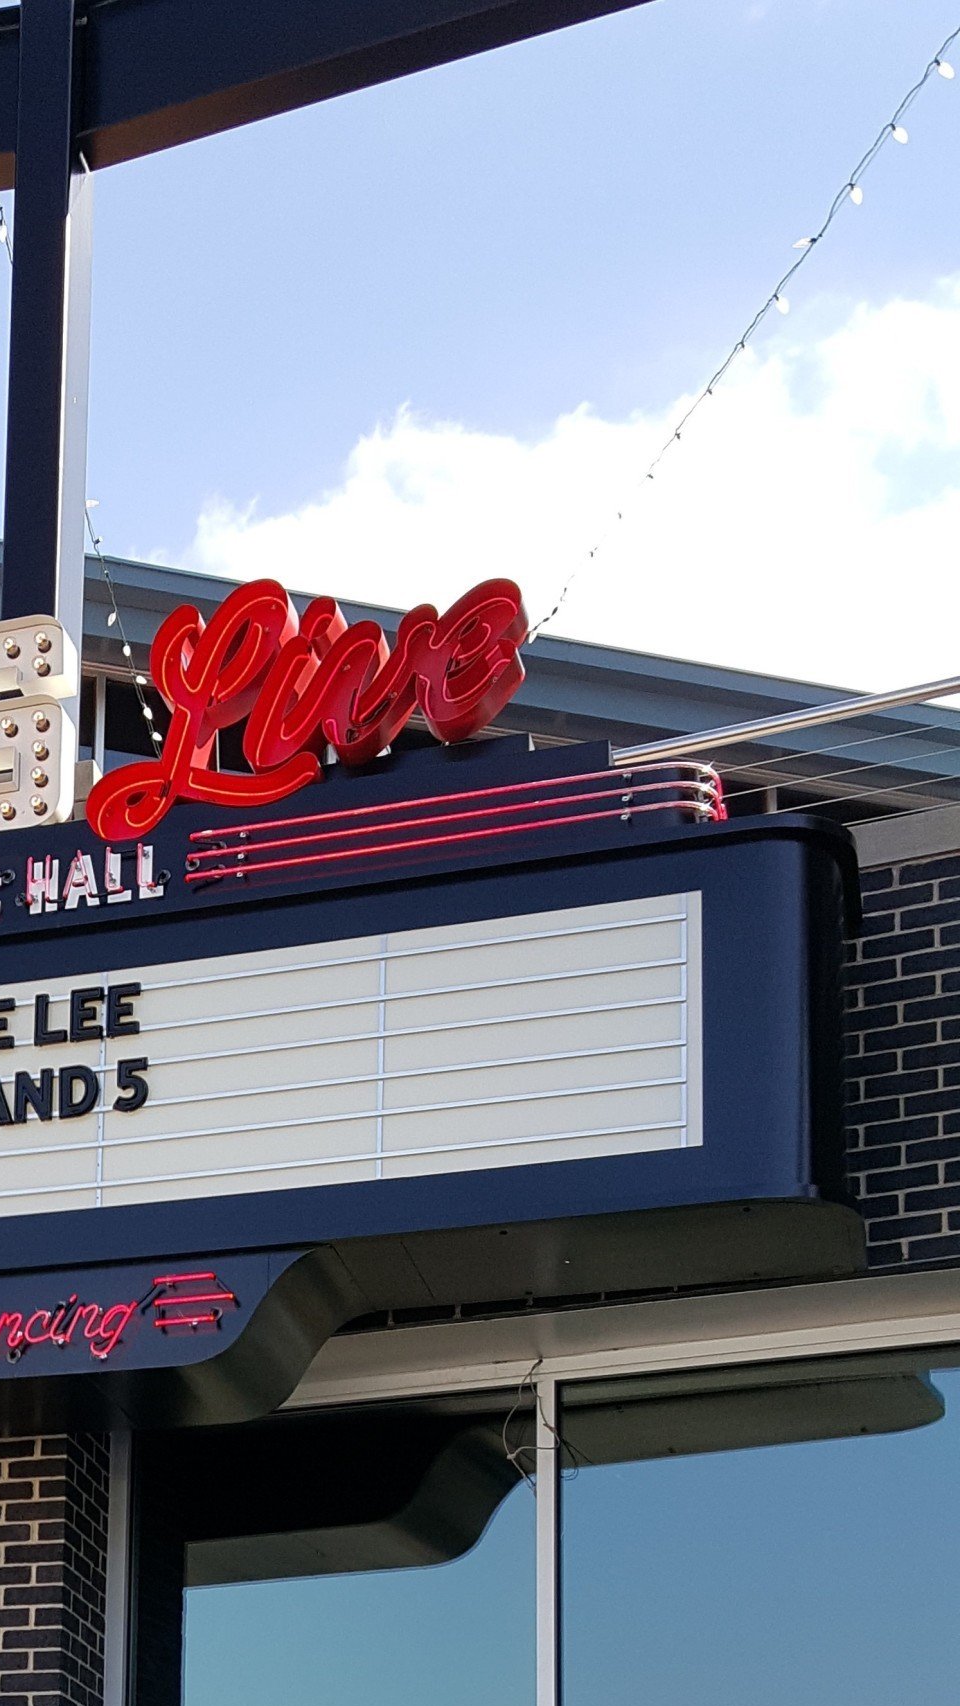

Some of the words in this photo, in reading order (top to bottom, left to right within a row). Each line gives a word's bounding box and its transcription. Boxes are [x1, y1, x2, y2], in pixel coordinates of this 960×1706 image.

[86, 578, 529, 843] Live
[25, 843, 164, 915] HALL
[33, 982, 141, 1047] LEE
[112, 1056, 149, 1112] 5
